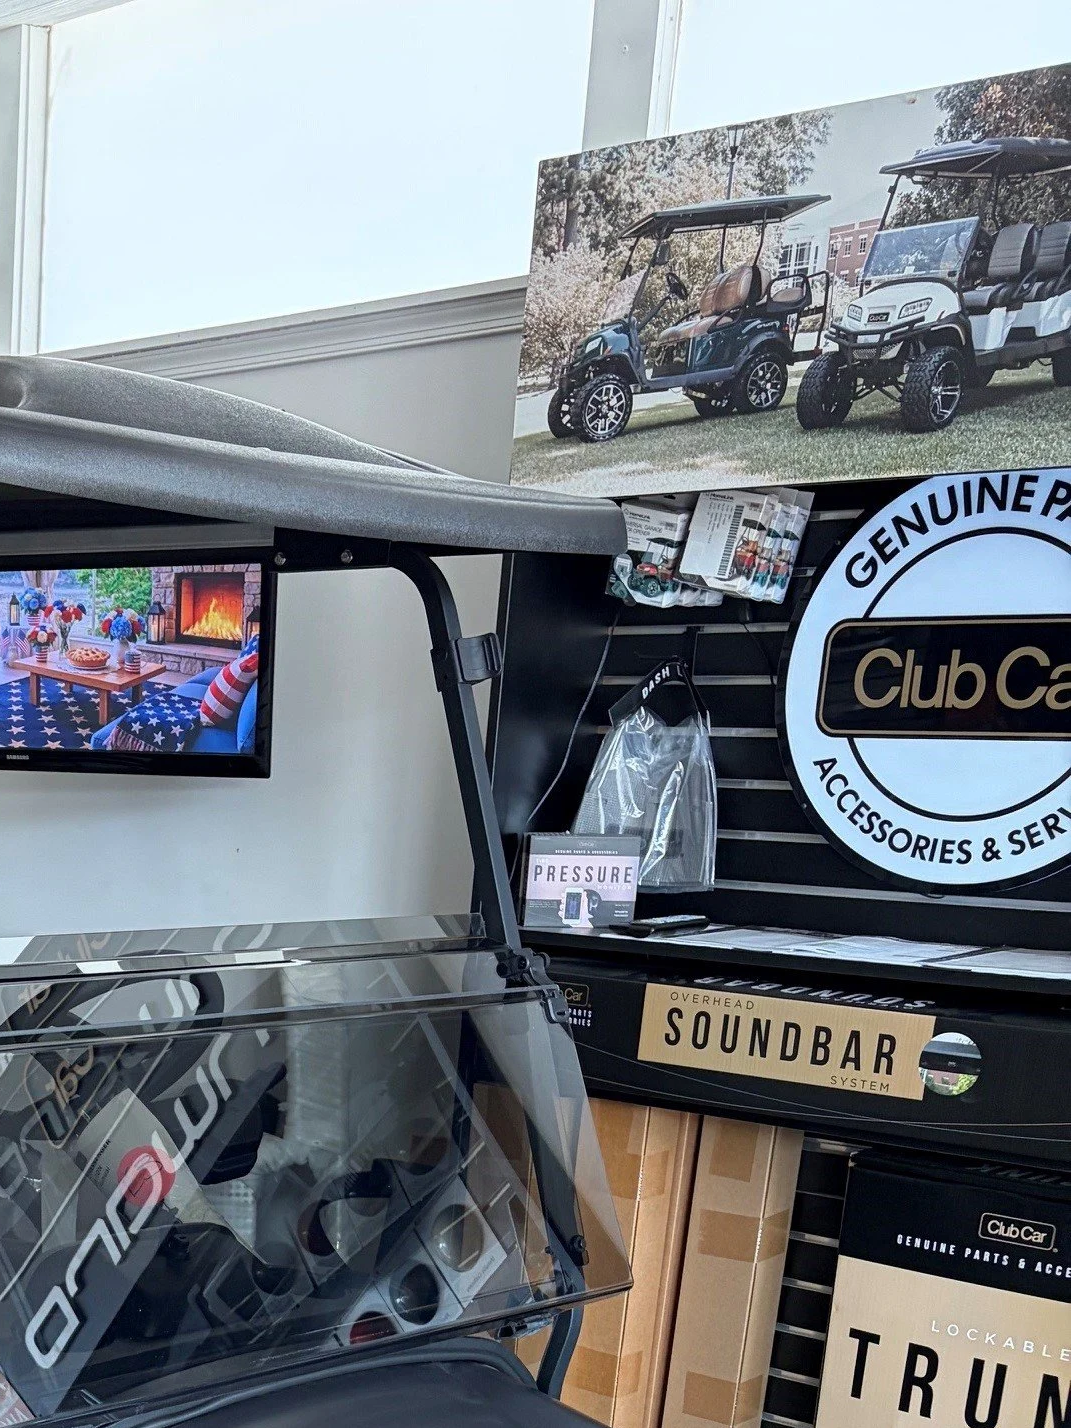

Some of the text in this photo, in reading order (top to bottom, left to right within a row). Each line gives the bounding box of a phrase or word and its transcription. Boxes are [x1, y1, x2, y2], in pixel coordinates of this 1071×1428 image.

[845, 473, 1040, 589] GENUINE
[642, 665, 670, 700] DASH
[853, 646, 1071, 710] Club Ca
[812, 756, 973, 865] ACCESSORIES
[981, 837, 1002, 862] &
[533, 864, 633, 884] PRESSURE
[564, 987, 583, 1001] Car
[669, 990, 756, 1011] OVERHEAD
[664, 1007, 897, 1076] SOUNDBAR
[829, 1074, 891, 1094] SYSTEM
[987, 1219, 1048, 1243] Club Car
[896, 1233, 1071, 1278] GENUINE PARTS & ACCE
[931, 1320, 1071, 1362] LOCKABLE
